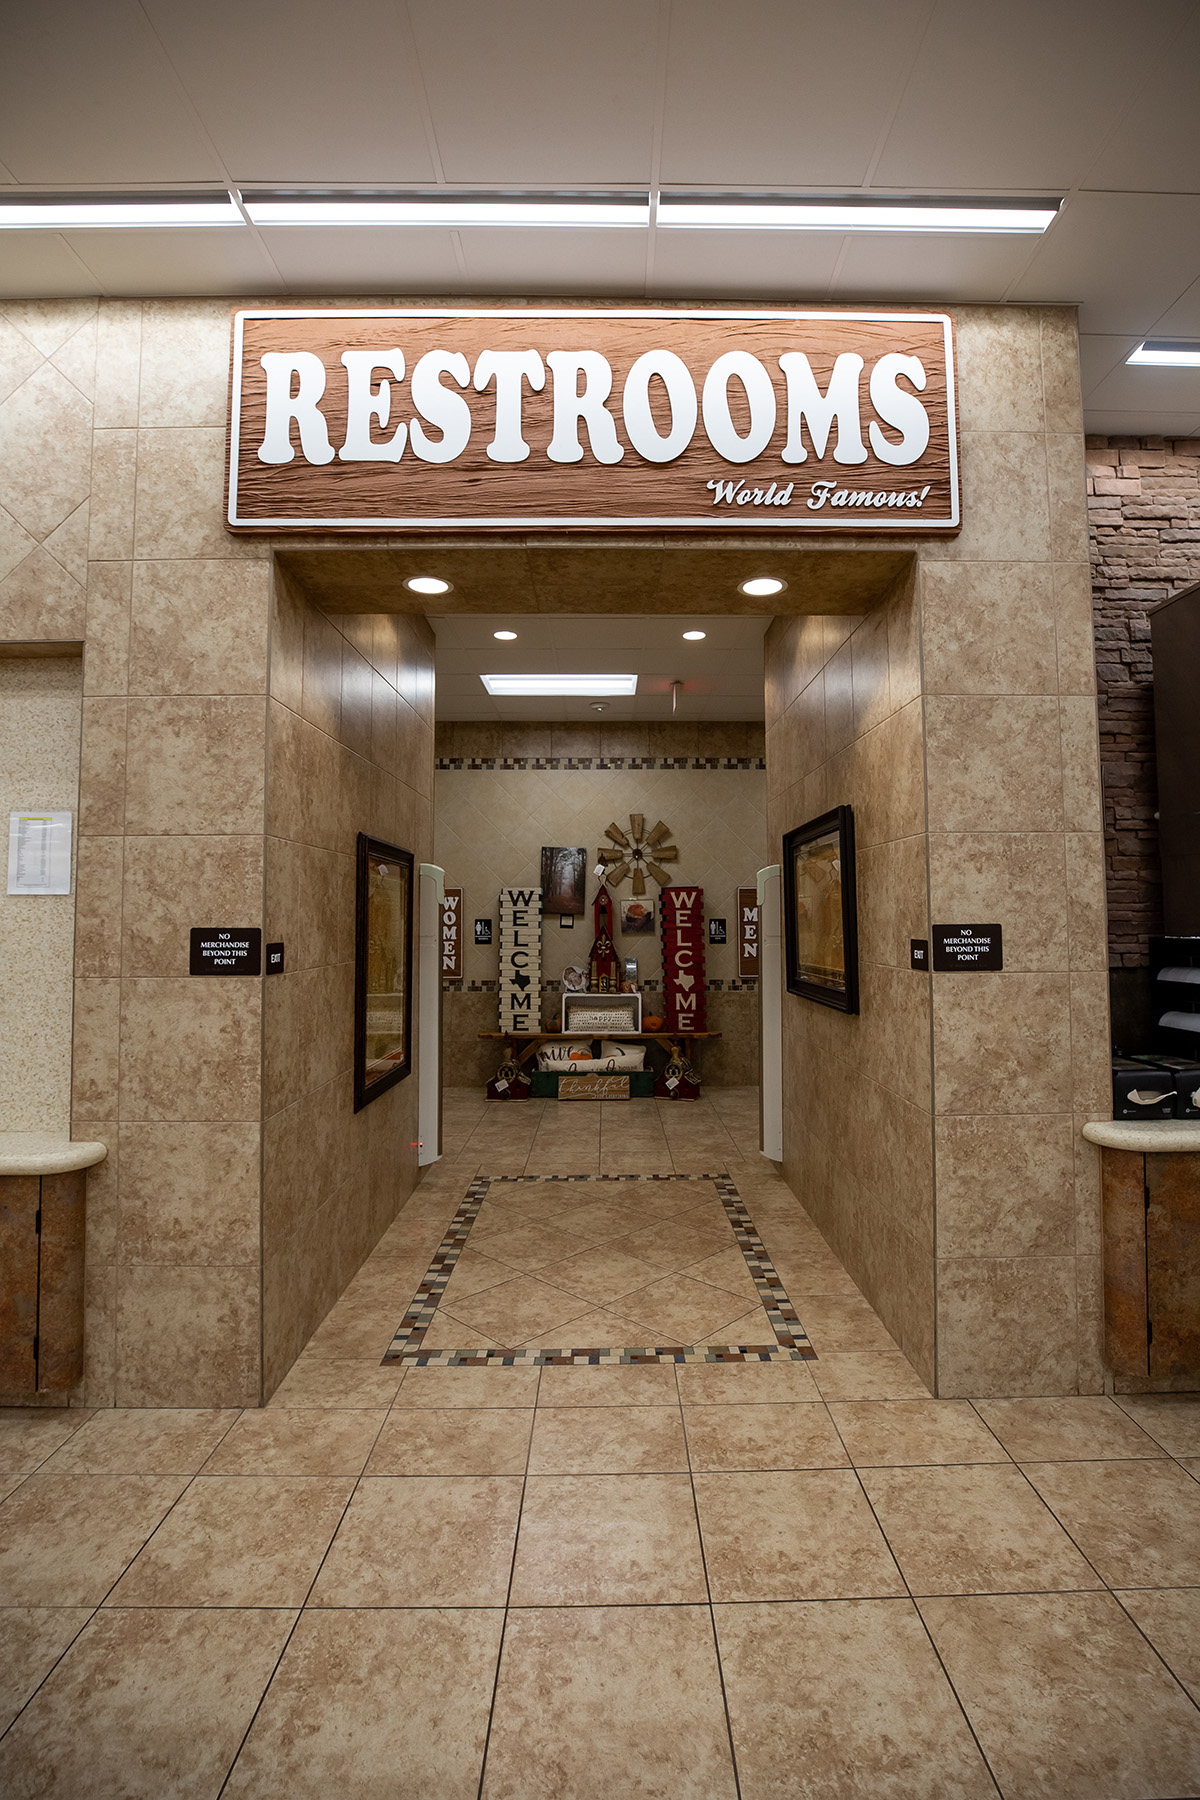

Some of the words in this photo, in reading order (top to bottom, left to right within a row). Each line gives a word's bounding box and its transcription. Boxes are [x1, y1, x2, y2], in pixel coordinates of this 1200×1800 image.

[258, 349, 931, 466] RESTROOMS
[706, 478, 794, 508] World
[806, 483, 931, 511] Famous!
[442, 896, 460, 970] WOMEN
[743, 907, 759, 958] MEN
[200, 941, 250, 949] MERCHANDISE
[943, 937, 991, 945] MERCHANDISE
[202, 949, 231, 957] BEYOND
[231, 949, 248, 957] THIS
[913, 949, 924, 960] EXIT
[945, 945, 974, 953] BEYOND
[974, 945, 990, 953] THIS
[270, 953, 281, 964] EXIT
[957, 953, 979, 961] POINT
